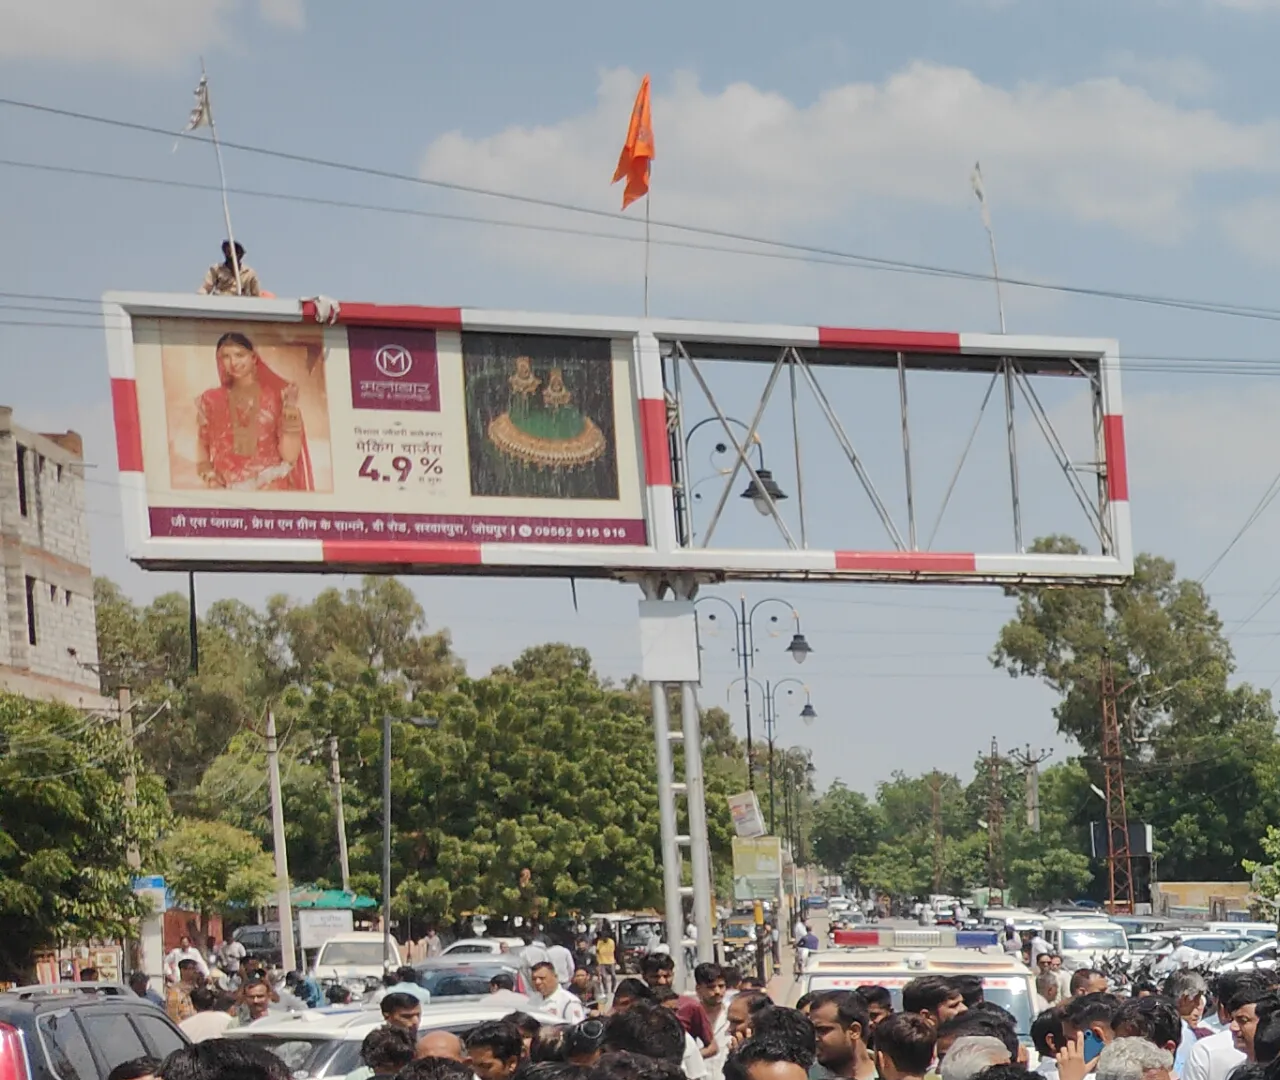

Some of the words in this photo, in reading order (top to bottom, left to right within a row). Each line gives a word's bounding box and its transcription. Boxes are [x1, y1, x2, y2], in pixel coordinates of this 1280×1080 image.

[358, 454, 412, 482] 4.9
[420, 457, 443, 475] %
[189, 516, 207, 529] एस
[278, 517, 293, 531] एन
[320, 516, 331, 531] के
[471, 521, 508, 539] जोधपुर
[577, 527, 599, 538] 916
[603, 528, 626, 539] 916
